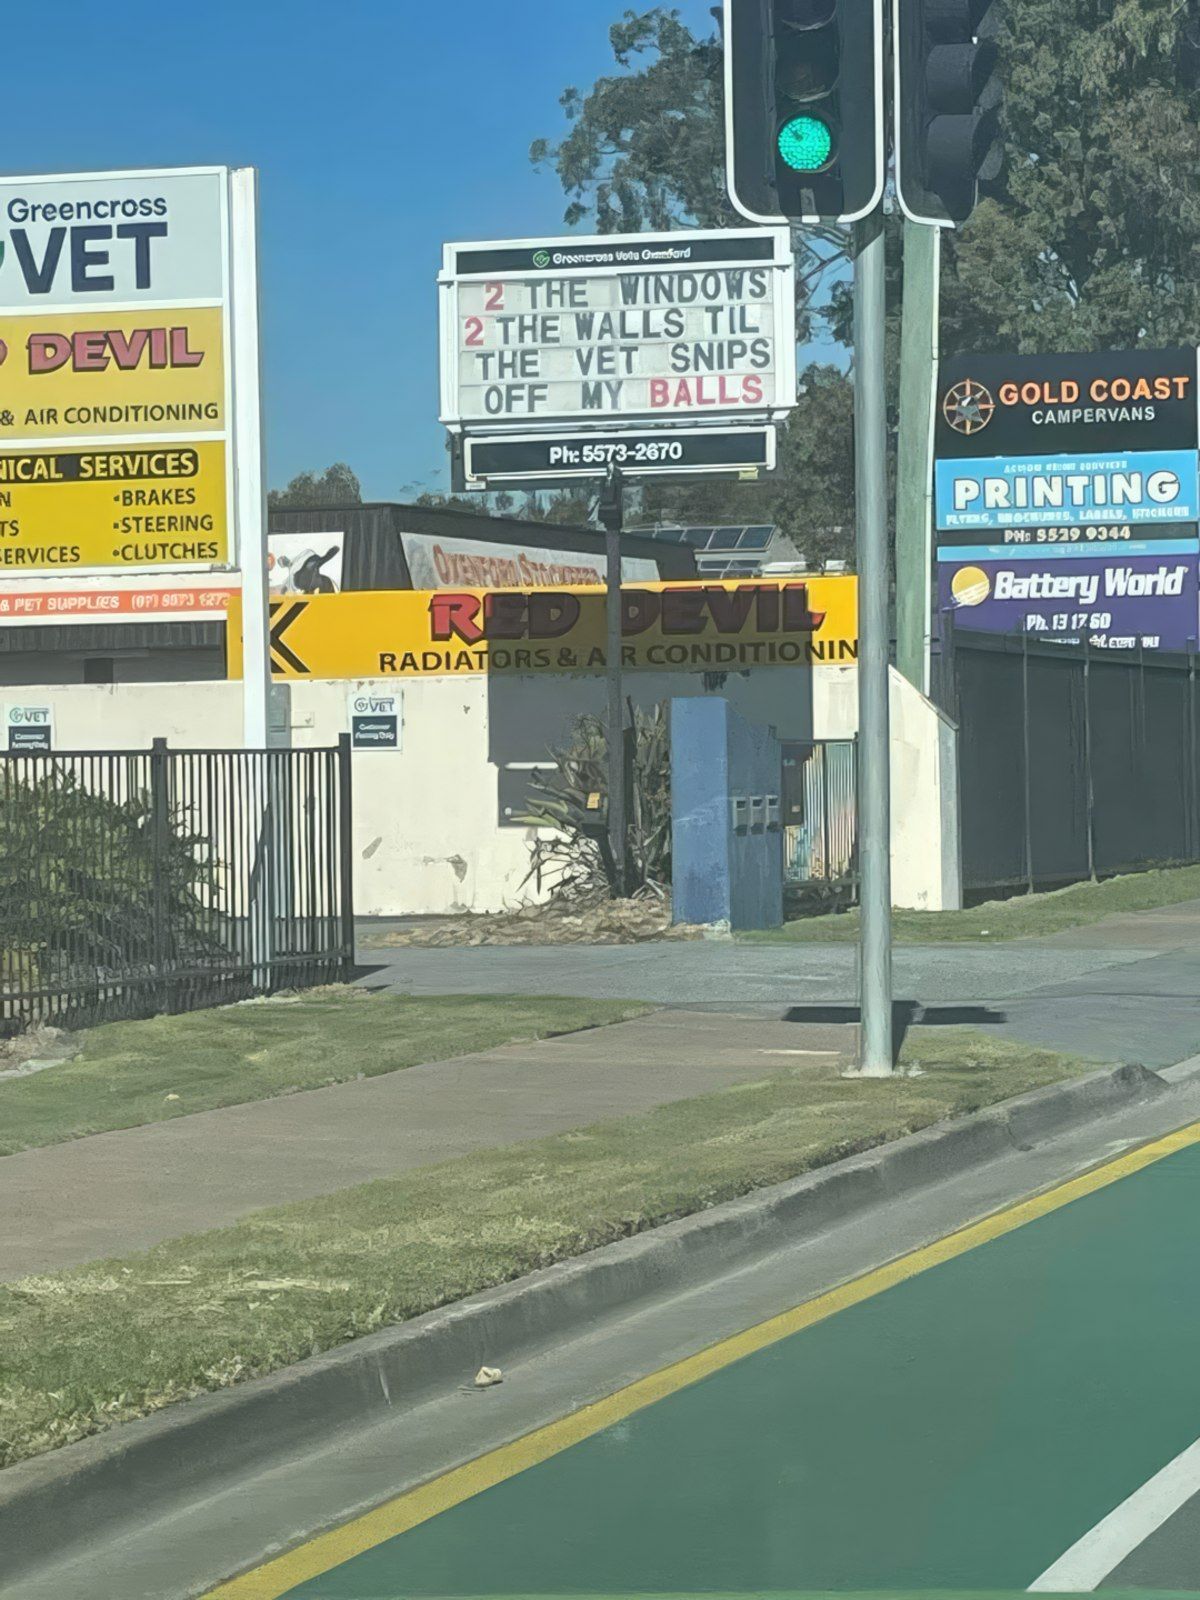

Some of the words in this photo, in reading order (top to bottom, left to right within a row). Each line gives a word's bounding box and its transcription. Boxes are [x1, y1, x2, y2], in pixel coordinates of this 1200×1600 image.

[7, 197, 168, 223] Greencross
[9, 221, 168, 294] VET
[485, 281, 504, 311] 2
[524, 280, 589, 309] THE
[619, 270, 767, 306] WINDOWS
[464, 317, 484, 346] 2
[496, 315, 561, 345] THE
[575, 308, 685, 341] WALLS
[705, 304, 760, 335] TIL
[26, 326, 205, 375] DEVIL
[476, 350, 540, 381] THE
[576, 346, 639, 376] VET
[670, 338, 771, 373] SNIPS
[484, 384, 548, 415] OFF
[581, 382, 624, 410] MY
[650, 374, 763, 408] BALLS
[999, 381, 1080, 406] GOLD
[1089, 377, 1190, 403] COAST
[24, 409, 58, 425] AIR
[63, 402, 219, 423] CONDITIONING
[1031, 406, 1156, 425] CAMPERVANS
[79, 450, 195, 478] SERVICES
[550, 447, 580, 464] Ph:
[582, 442, 683, 463] 5573-2670
[122, 488, 196, 507] BRAKES
[953, 471, 1181, 511] PRINTING
[121, 515, 213, 533] STEERING
[1085, 526, 1131, 541] 9344
[0, 546, 80, 565] ERVICES
[121, 542, 218, 561] CLUTCHES
[994, 571, 1100, 605] Battery
[1105, 566, 1183, 597] World
[428, 591, 580, 646] RED
[620, 583, 826, 637] DEVIL
[1052, 614, 1068, 630] 13
[379, 649, 550, 672] RADIATORS
[557, 647, 577, 667] &
[587, 645, 636, 668] AR
[646, 639, 859, 665] CONDITIONIN
